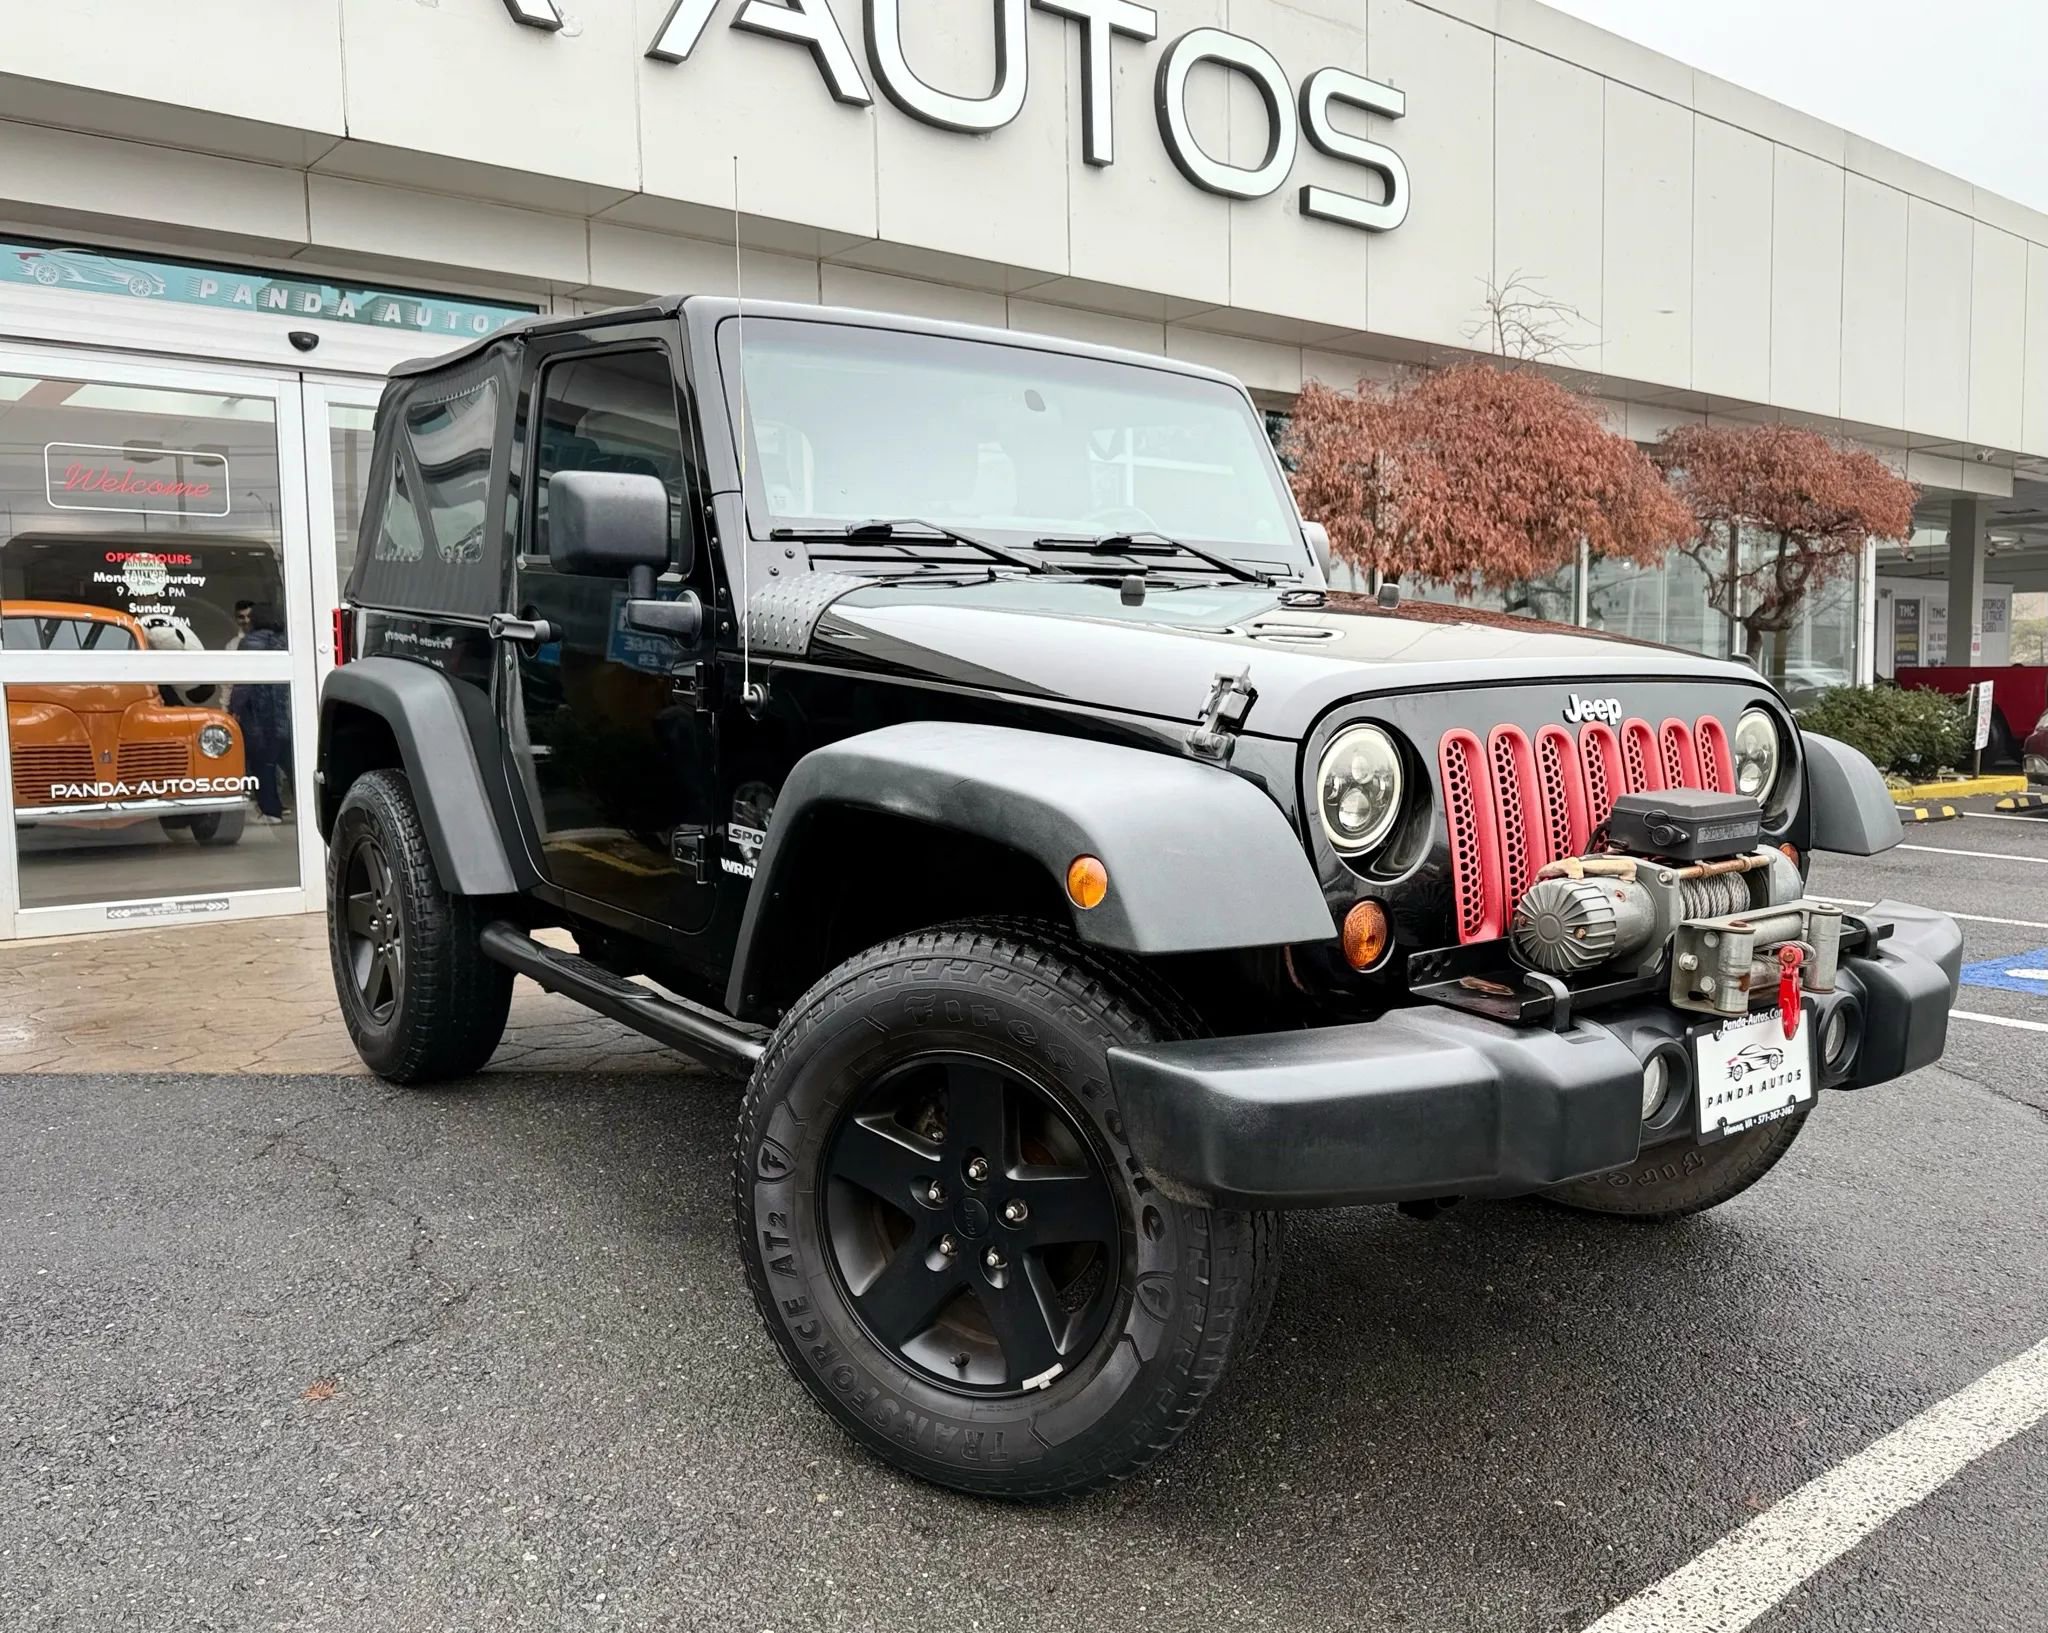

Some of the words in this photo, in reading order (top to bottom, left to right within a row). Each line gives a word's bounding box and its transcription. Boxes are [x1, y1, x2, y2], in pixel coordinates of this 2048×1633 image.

[645, 0, 1410, 233] AUTOS
[198, 278, 356, 318] PANDA
[64, 462, 211, 497] Welcome
[116, 586, 124, 597] 9
[169, 587, 186, 597] PM
[129, 603, 176, 616] Sunday
[1563, 694, 1622, 726] Jeep
[731, 828, 765, 845] SPO
[1706, 1085, 1753, 1108] PANDA
[1761, 1069, 1801, 1092] AUTOS
[765, 1210, 797, 1279] AT2
[782, 1295, 1010, 1463] TRANSFORCE
